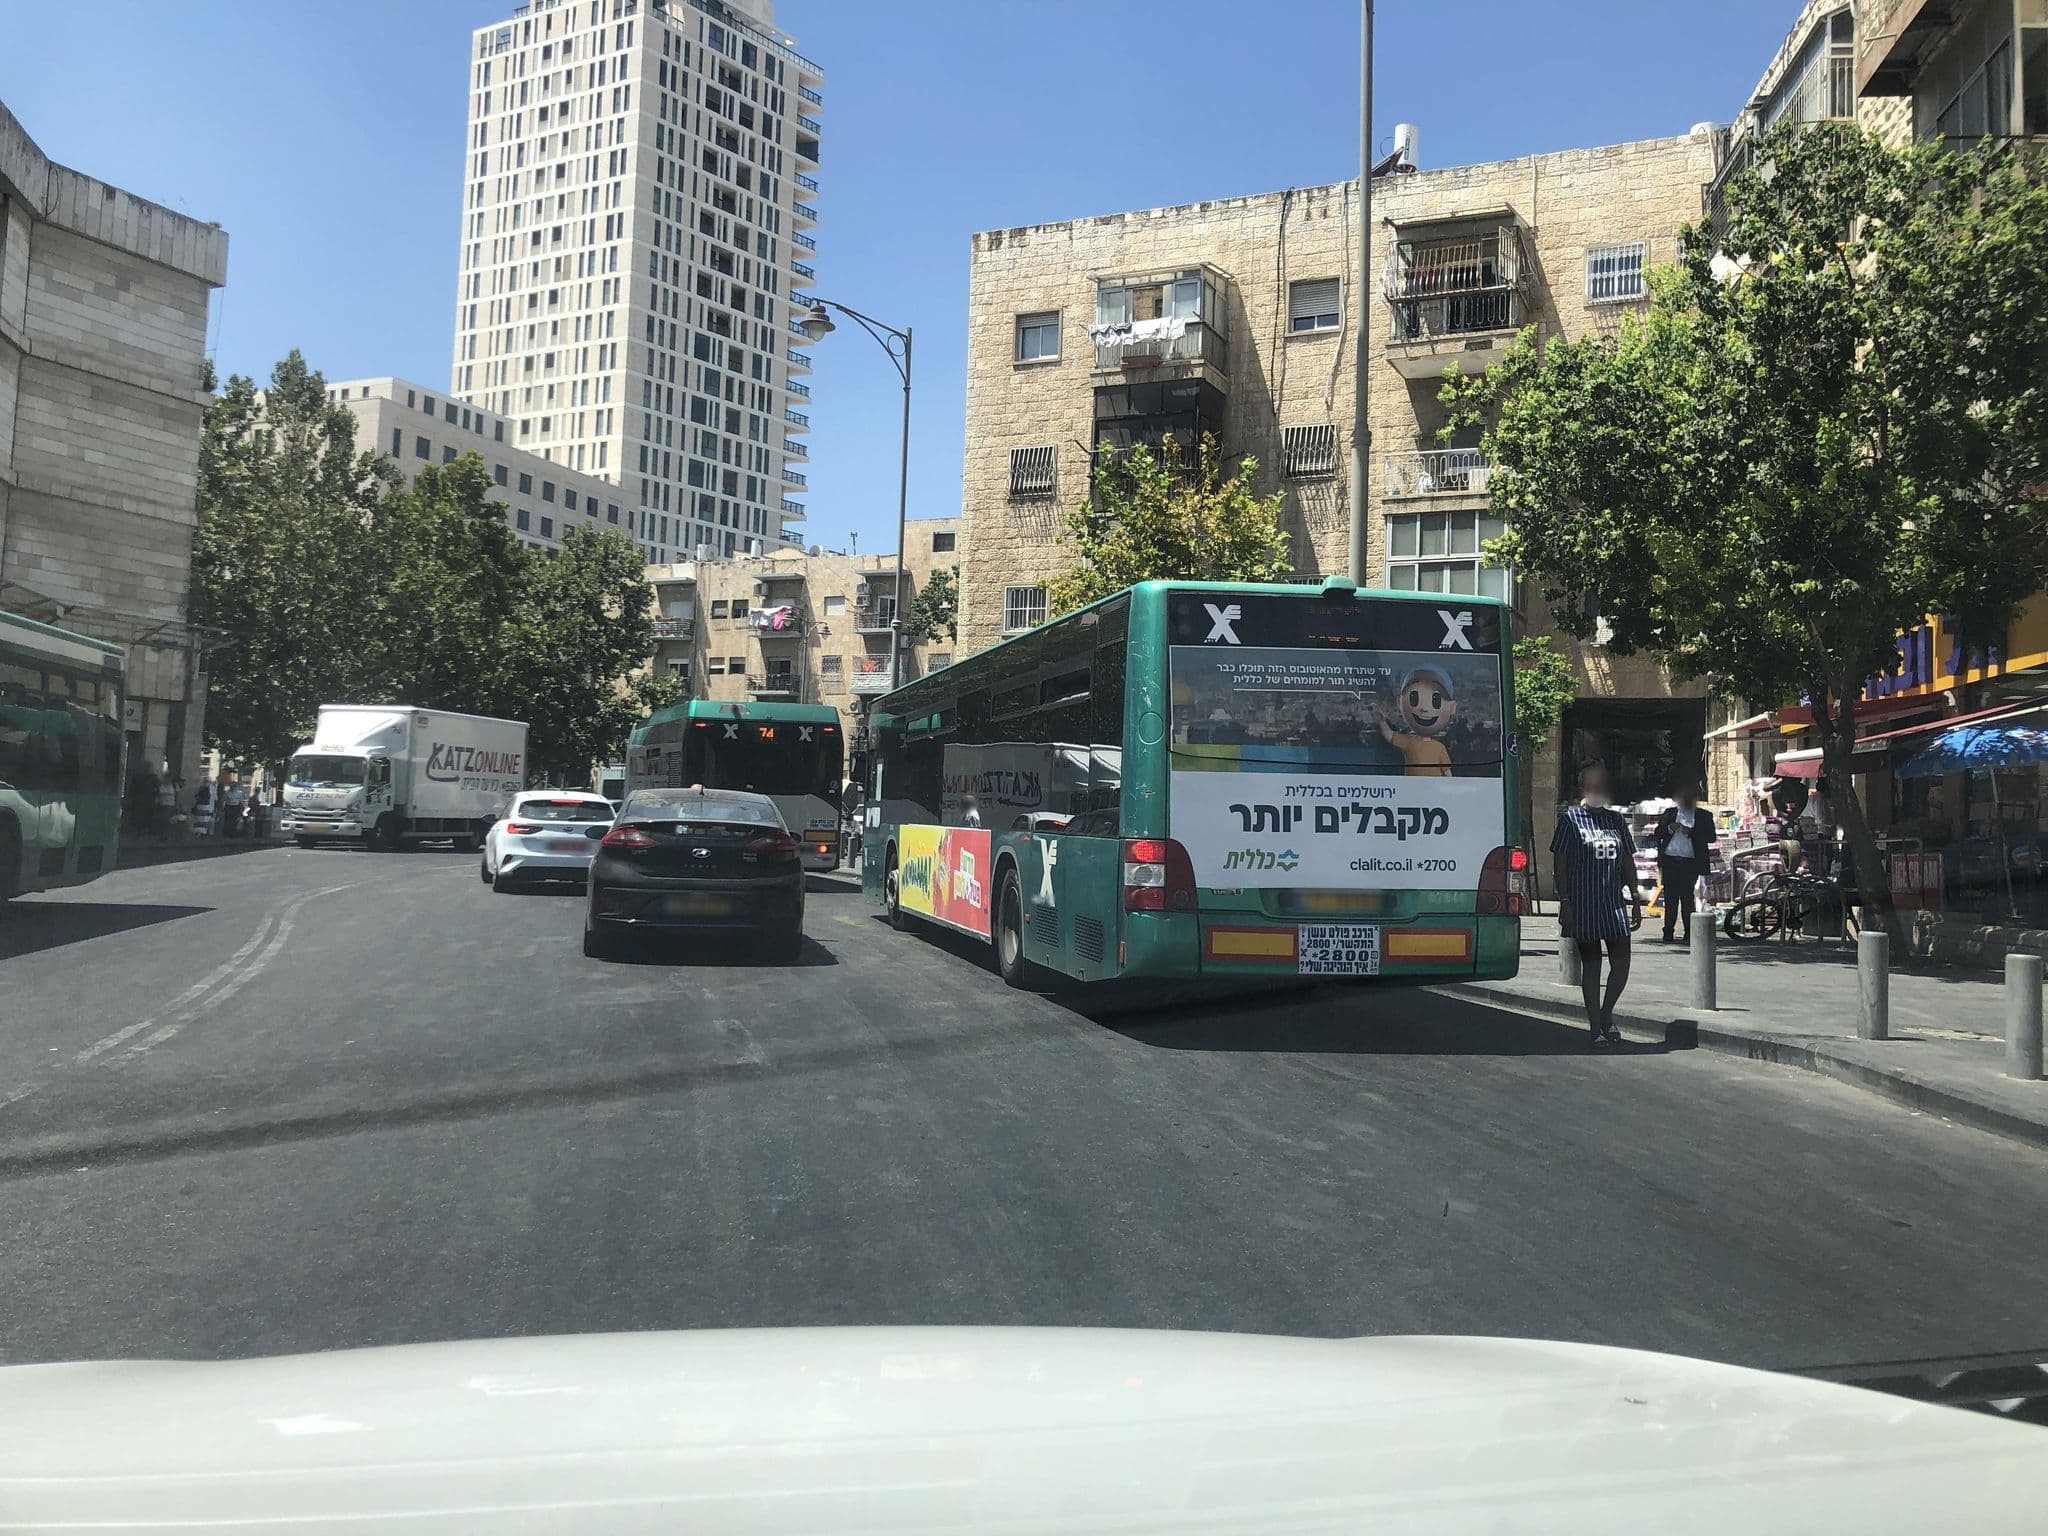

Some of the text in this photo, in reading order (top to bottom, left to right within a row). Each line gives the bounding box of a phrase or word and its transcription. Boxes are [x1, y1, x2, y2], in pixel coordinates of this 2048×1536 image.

[1216, 663, 1392, 676] עד שתרדו מהאוטובוס הזה תוכלו כבר
[1232, 673, 1377, 686] להשיג תור למומחים של כללית
[1284, 784, 1396, 799] ירושלמים בכללית
[1228, 801, 1450, 841] מקבלים יותר
[1222, 848, 1276, 869] כללית
[1349, 857, 1413, 872] clalit.co.il
[1352, 927, 1374, 938] הרכב
[1323, 961, 1353, 973] הנהיגה
[1354, 961, 1369, 973] איך
